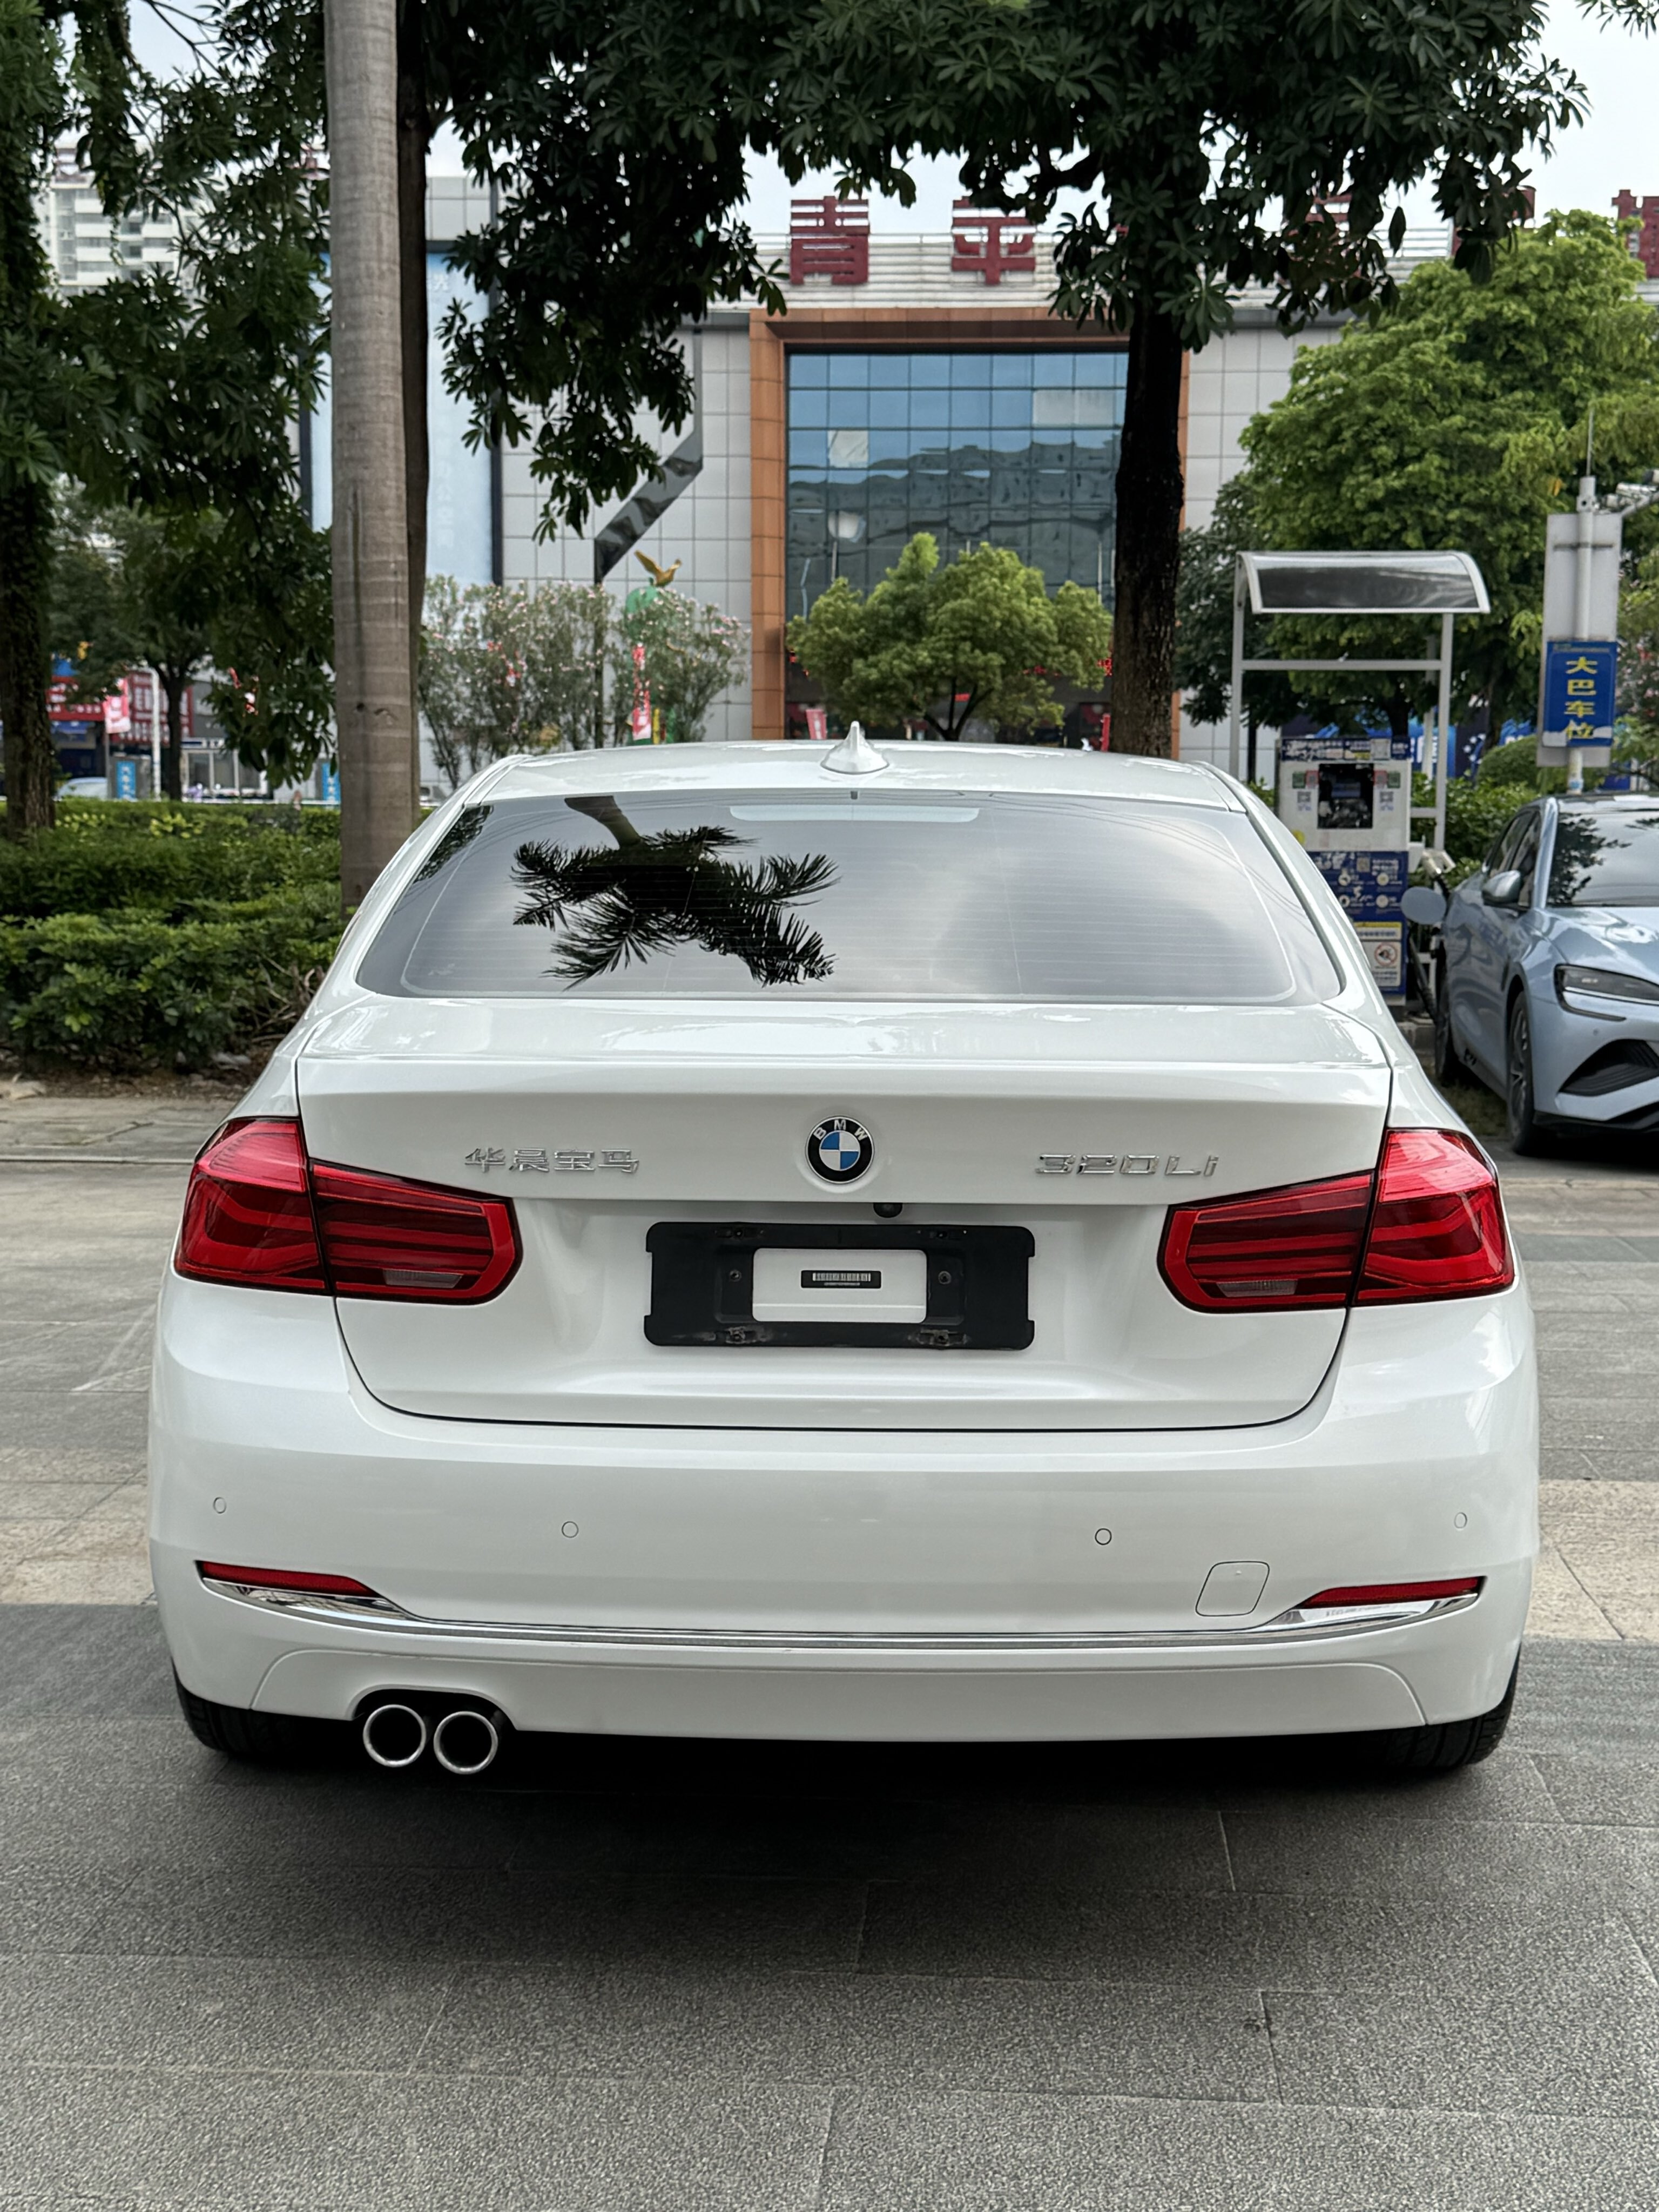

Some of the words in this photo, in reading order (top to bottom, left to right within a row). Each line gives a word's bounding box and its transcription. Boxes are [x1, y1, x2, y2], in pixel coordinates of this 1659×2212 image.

[1564, 656, 1599, 740] 大巴车位
[813, 1120, 868, 1141] BMW
[464, 1148, 639, 1174] 华晨宝马
[1034, 1154, 1220, 1177] 320Li
